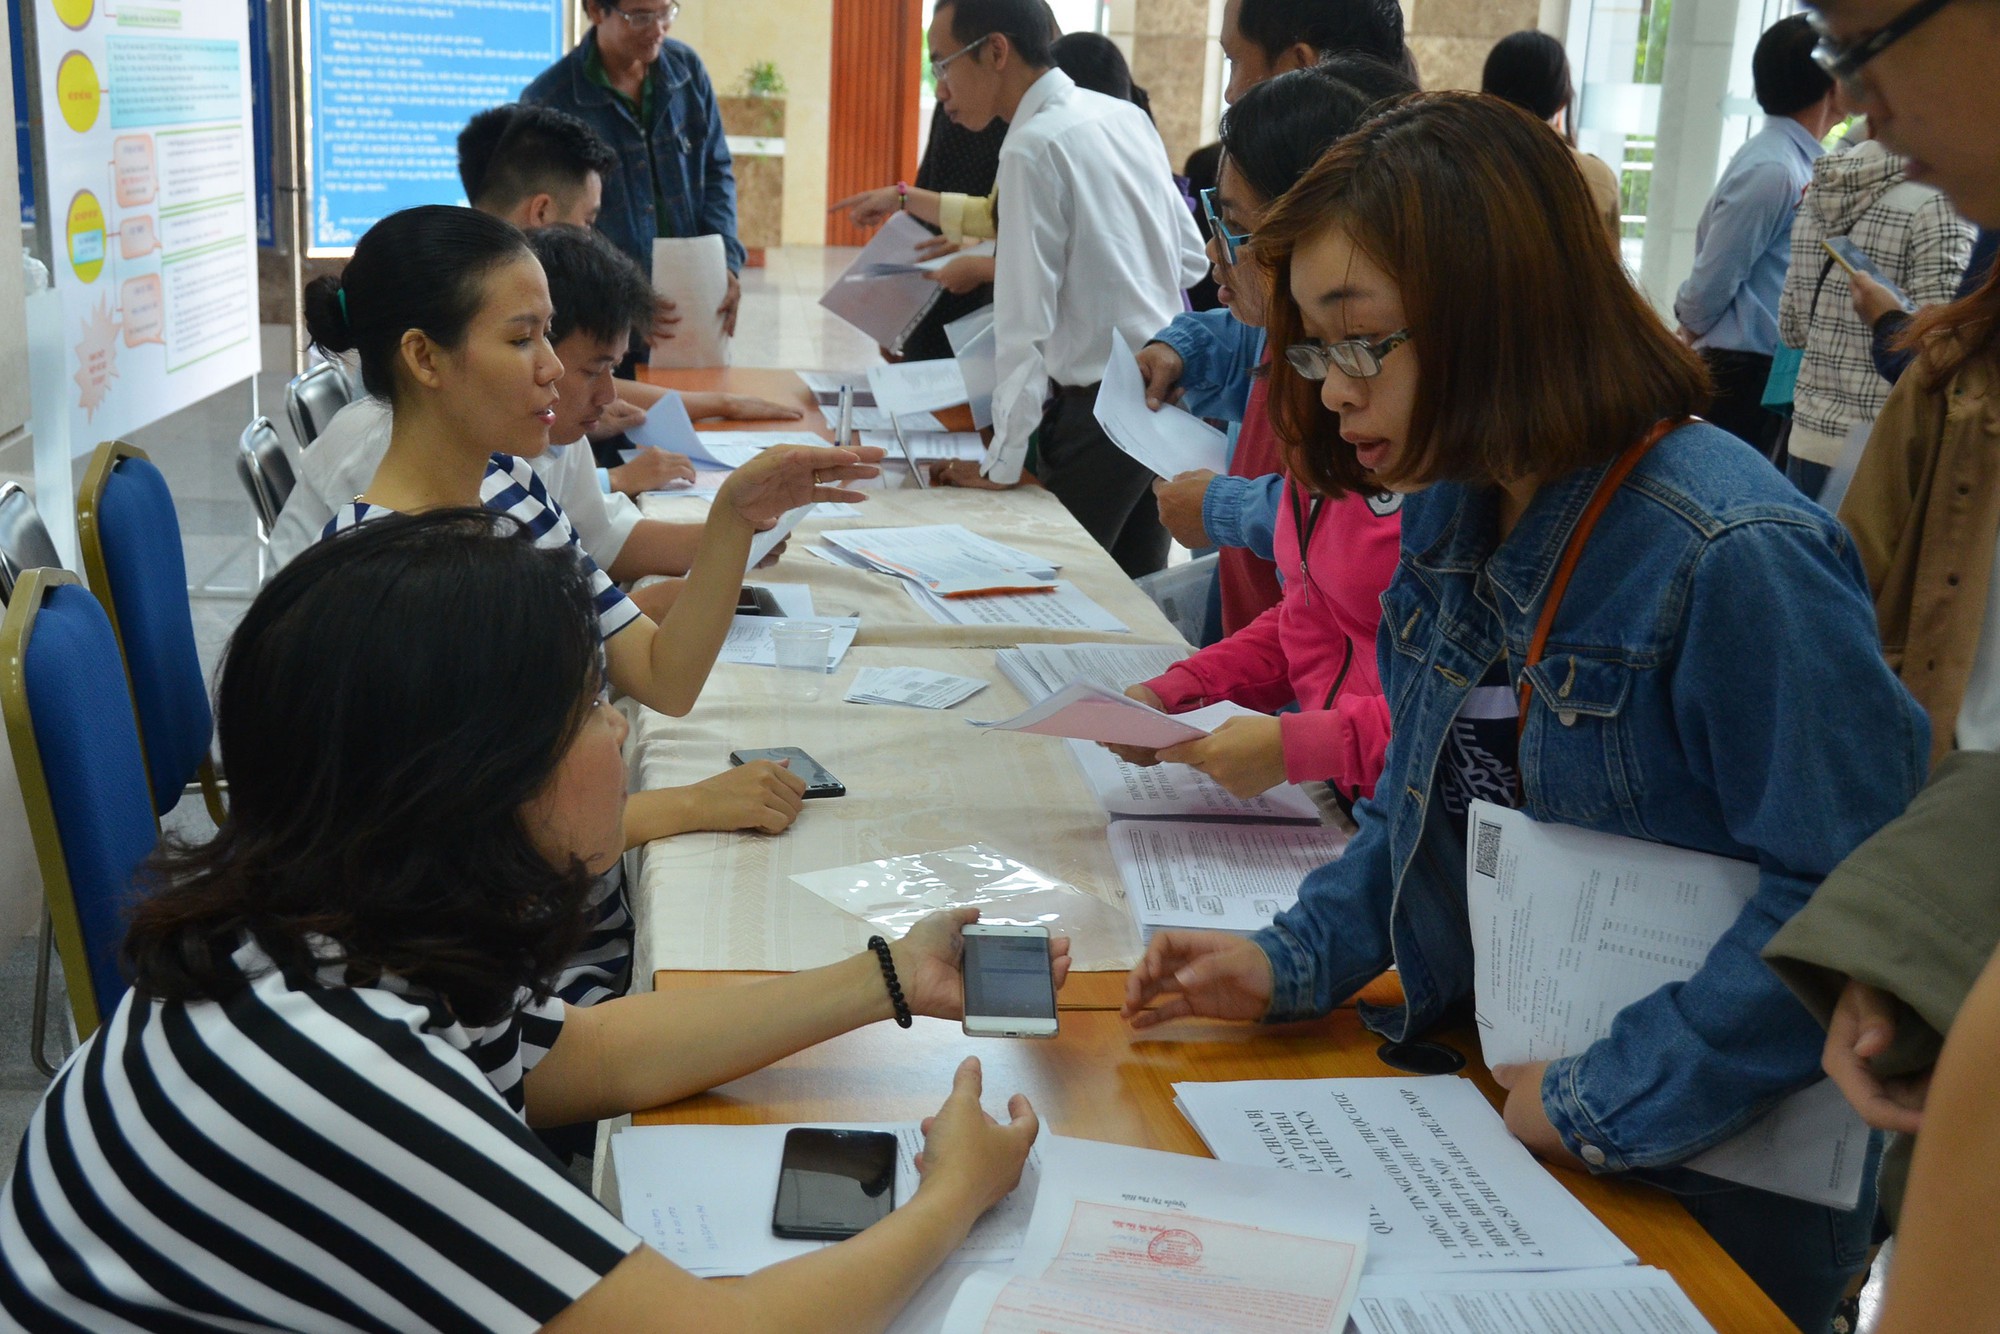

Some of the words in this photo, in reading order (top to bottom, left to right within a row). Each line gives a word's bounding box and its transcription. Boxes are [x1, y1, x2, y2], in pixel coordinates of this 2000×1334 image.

[1331, 1092, 1357, 1114] GTGC
[1400, 1089, 1422, 1105] NỘP
[1244, 1110, 1263, 1119] BỊ
[1270, 1112, 1298, 1135] KHAI
[1294, 1111, 1322, 1136] TNCN
[1411, 1107, 1432, 1118] ĐÃ
[1252, 1122, 1285, 1154] CHUẨN
[1348, 1115, 1379, 1144] THUỘC
[1378, 1127, 1408, 1149] THUẾ
[1284, 1138, 1308, 1152] TỜ
[1309, 1138, 1342, 1164] THUẾ
[1370, 1146, 1394, 1162] PHỤ
[1399, 1152, 1425, 1172] CHỊU
[1430, 1158, 1453, 1175] NỘP
[1458, 1166, 1480, 1178] ĐÃ
[1384, 1164, 1416, 1193] NGƯỜI
[1417, 1174, 1446, 1198] NHẬP
[1442, 1177, 1464, 1189] ĐÃ
[1468, 1180, 1500, 1204] THUẾ
[1407, 1196, 1429, 1211] TIN
[1436, 1201, 1462, 1219] THU
[1455, 1192, 1486, 1216] BHYT
[1490, 1206, 1513, 1218] SỐ
[1422, 1215, 1457, 1248] THÔNG
[1478, 1218, 1510, 1246] BHXH,
